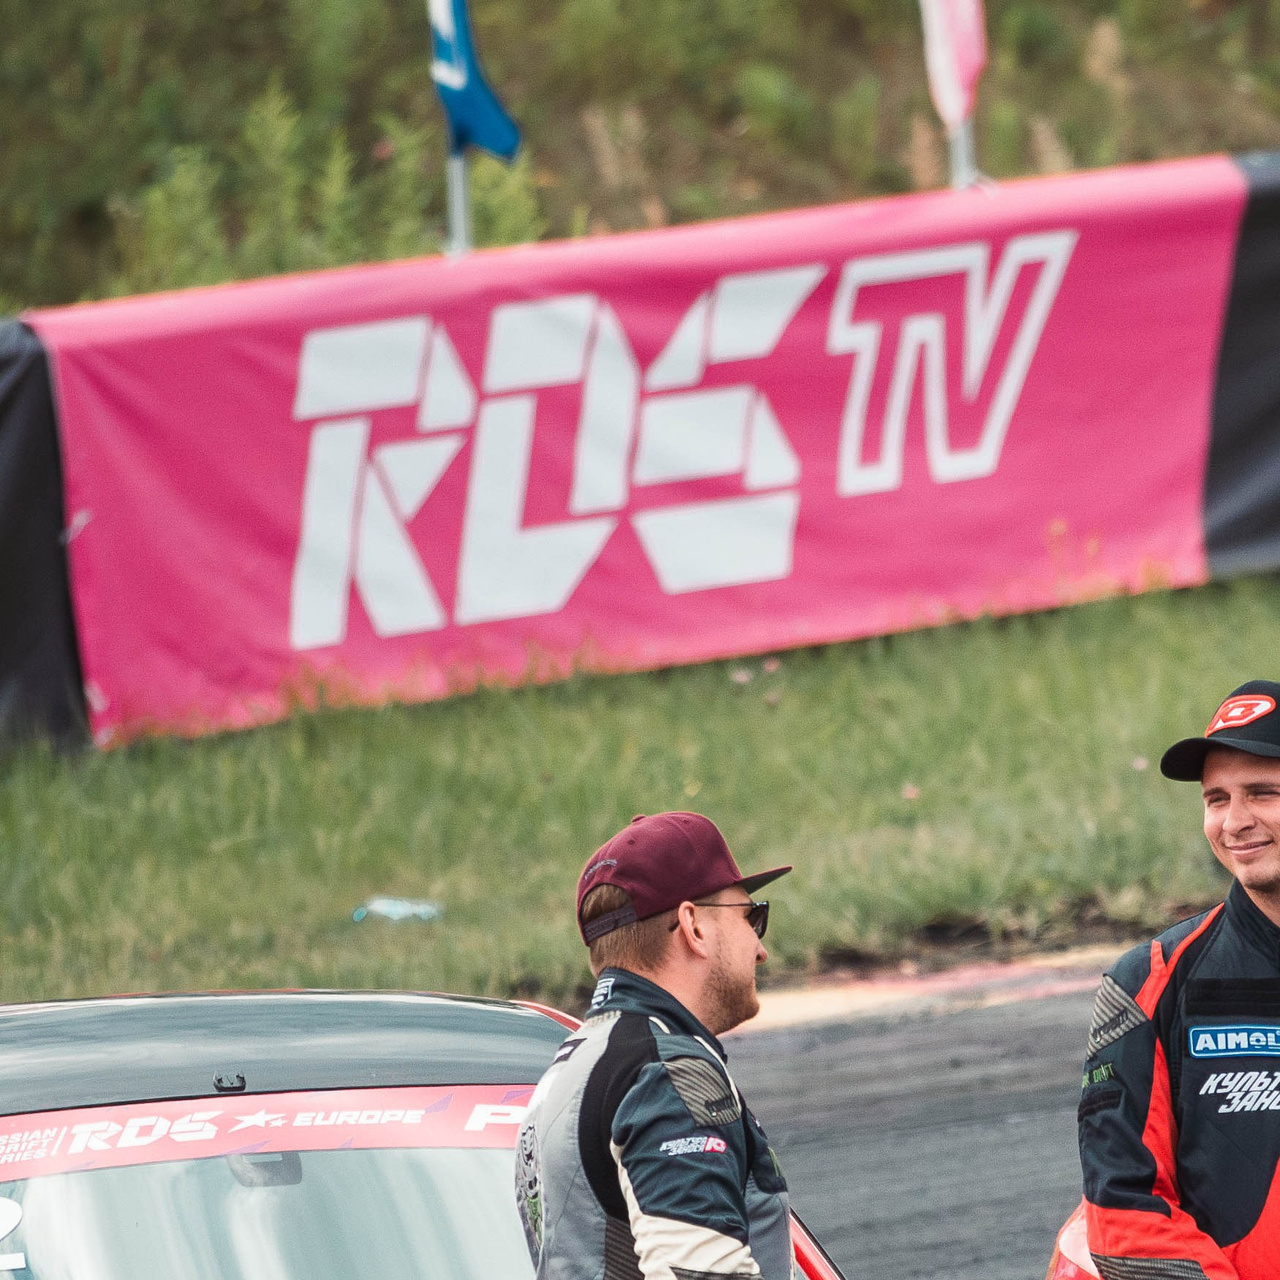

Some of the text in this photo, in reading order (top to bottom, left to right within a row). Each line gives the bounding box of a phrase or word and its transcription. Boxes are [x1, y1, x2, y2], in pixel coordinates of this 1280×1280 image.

[290, 264, 826, 651] RDS
[67, 1109, 427, 1155] RDS EUROPE
